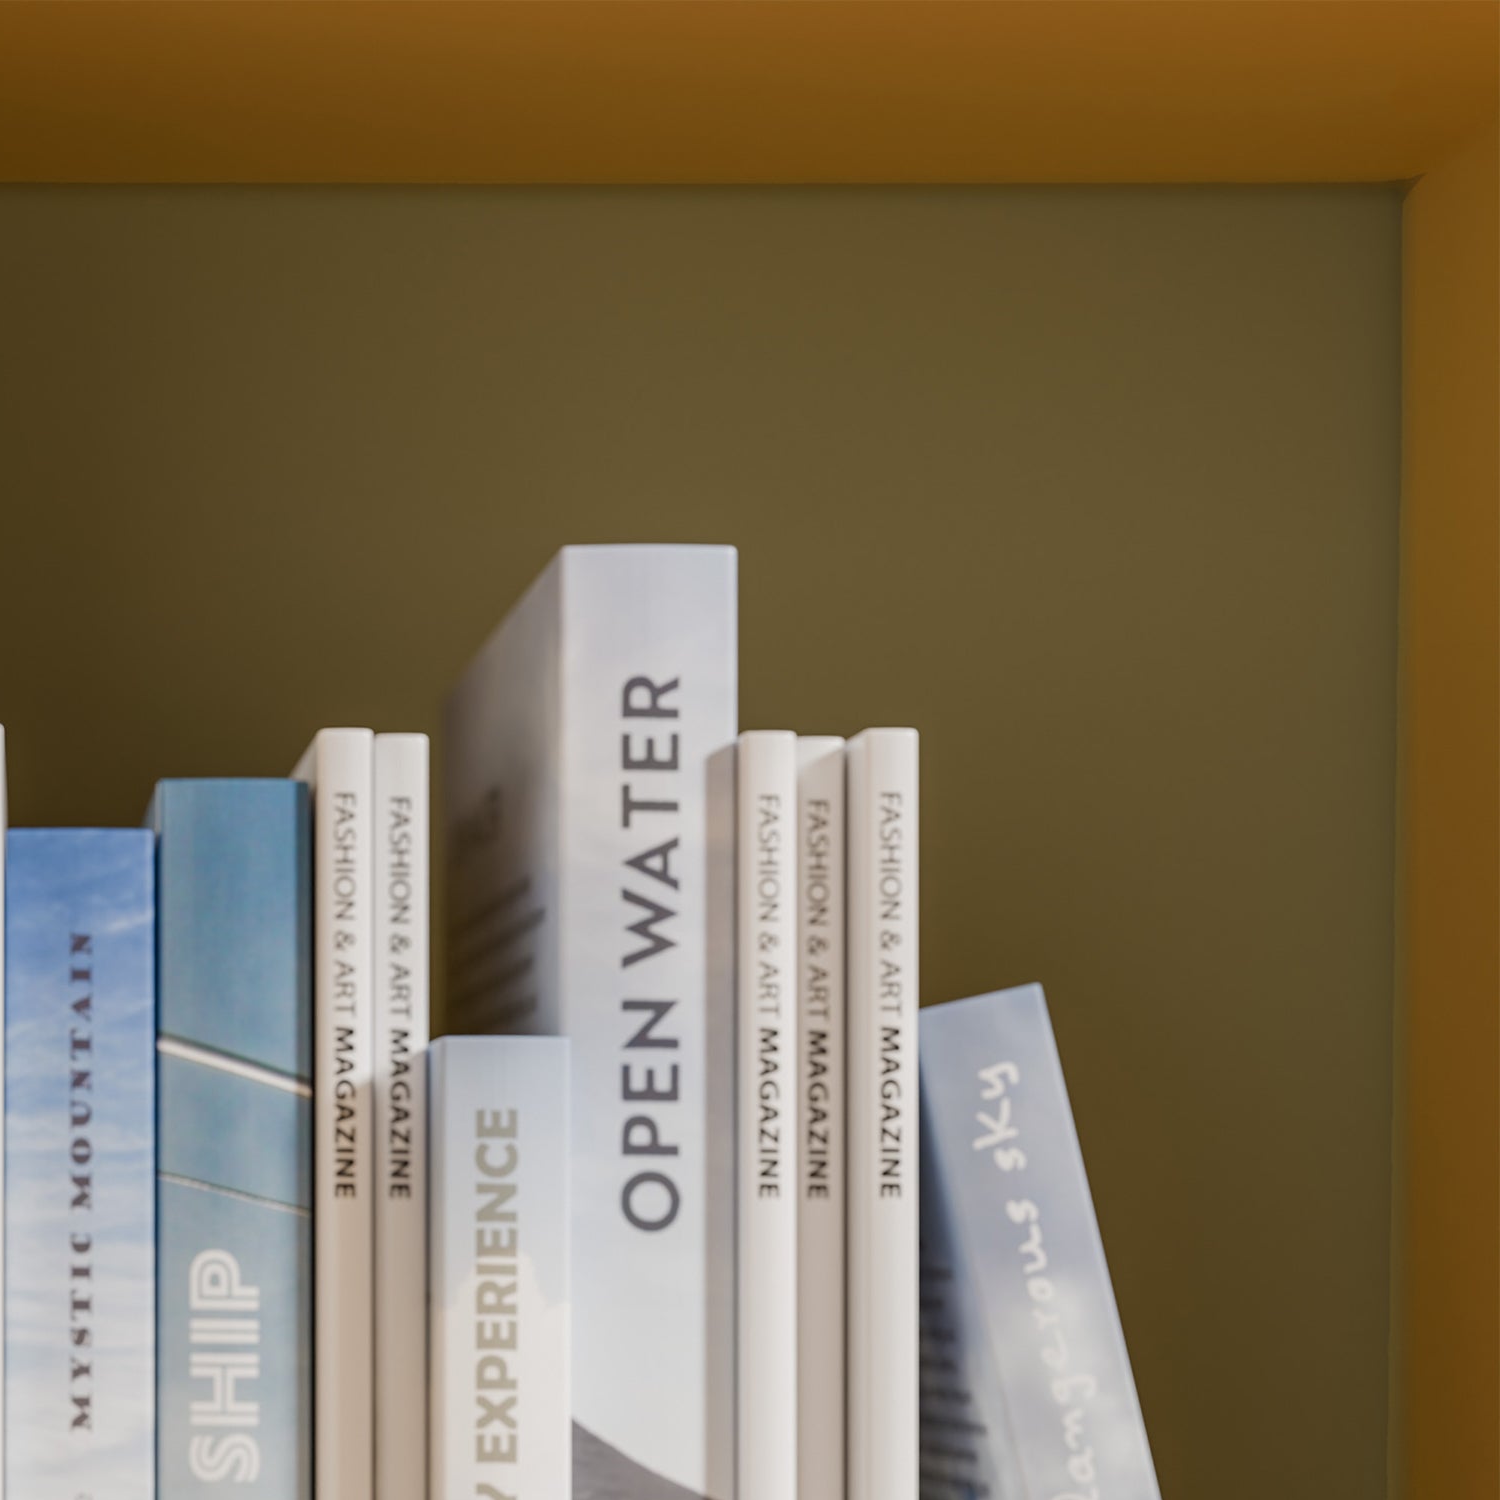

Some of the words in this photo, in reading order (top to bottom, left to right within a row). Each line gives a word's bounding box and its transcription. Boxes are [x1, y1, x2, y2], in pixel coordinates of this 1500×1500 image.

[333, 792, 357, 920] FASHION
[389, 796, 412, 924] FASHION
[621, 675, 680, 968] WATER
[758, 794, 780, 922] FASHION
[807, 799, 830, 926] FASHION
[880, 791, 902, 920] FASHION
[333, 960, 357, 1018] ART
[334, 930, 357, 951] &
[389, 963, 412, 1020] ART
[390, 934, 412, 955] &
[758, 961, 780, 1018] ART
[759, 932, 780, 952] &
[807, 965, 830, 1022] ART
[808, 935, 830, 956] &
[880, 958, 902, 1016] ART
[881, 929, 902, 950] &
[70, 932, 93, 1210] MOUNTAIN
[333, 1026, 357, 1199] MAGAZINE
[389, 1029, 412, 1199] MAGAZINE
[621, 1000, 681, 1232] OPEN
[758, 1026, 780, 1198] MAGAZINE
[807, 1029, 830, 1198] MAGAZINE
[880, 1025, 902, 1198] MAGAZINE
[70, 1232, 93, 1432] MYSTIC
[475, 1108, 519, 1464] EXPERIENCE
[189, 1248, 260, 1482] SHIP
